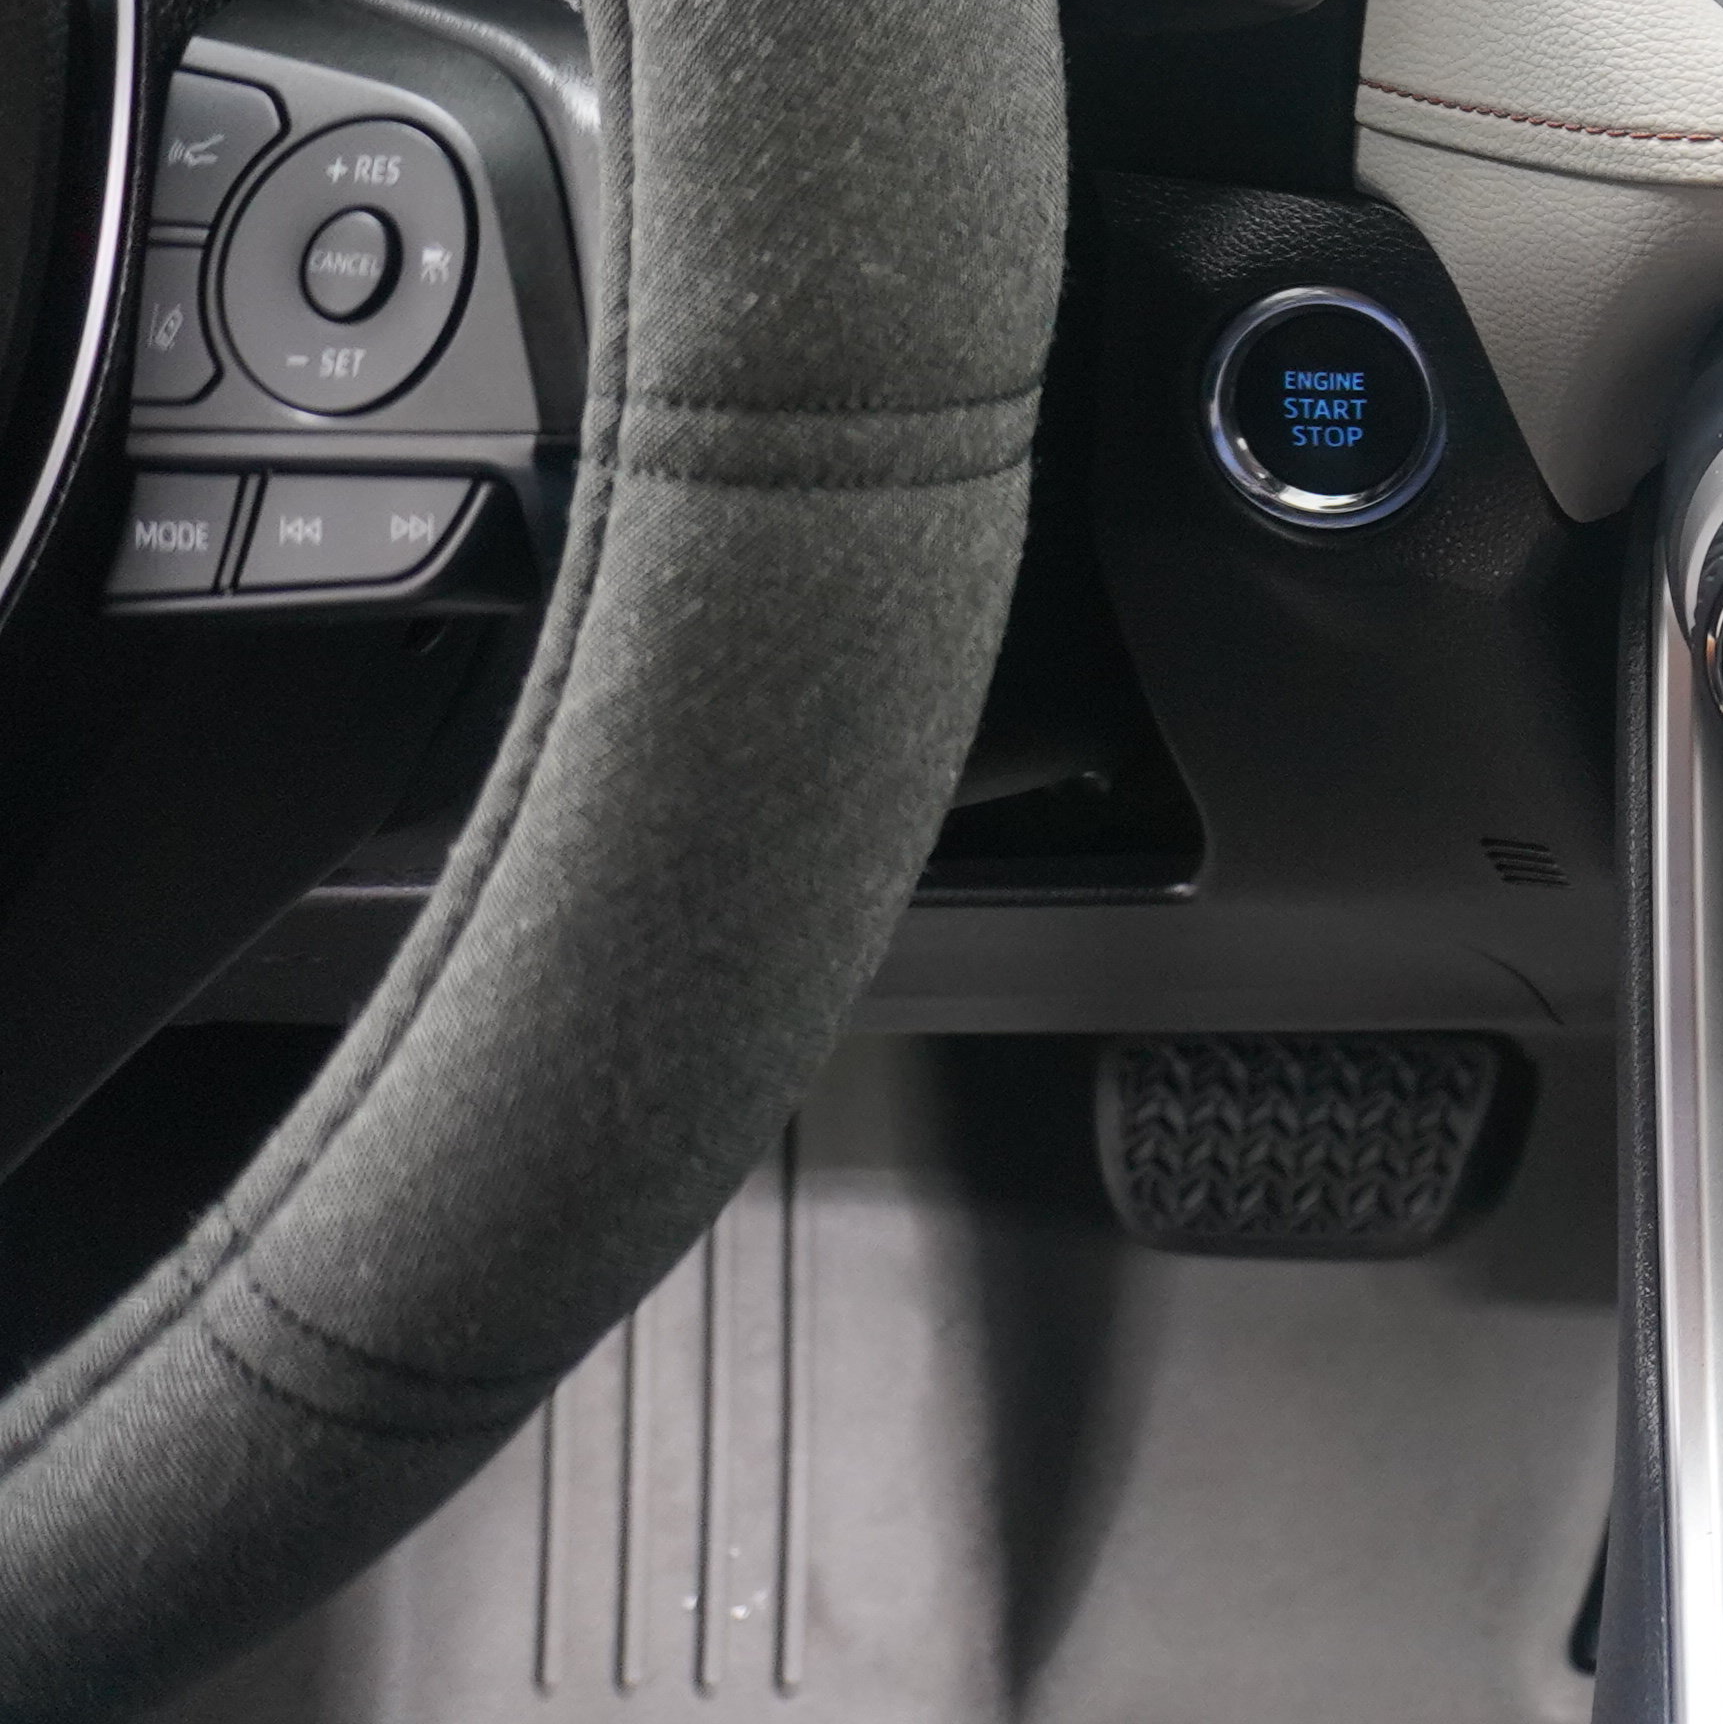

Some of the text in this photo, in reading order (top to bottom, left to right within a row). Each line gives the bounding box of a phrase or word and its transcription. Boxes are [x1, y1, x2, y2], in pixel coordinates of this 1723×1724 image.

[355, 154, 402, 186] RES
[309, 250, 380, 277] CANCEL
[319, 347, 366, 378] SET
[1284, 370, 1365, 392] ENGINE
[1283, 398, 1367, 420] START
[1291, 425, 1363, 448] STOP
[134, 520, 209, 552] MODE
